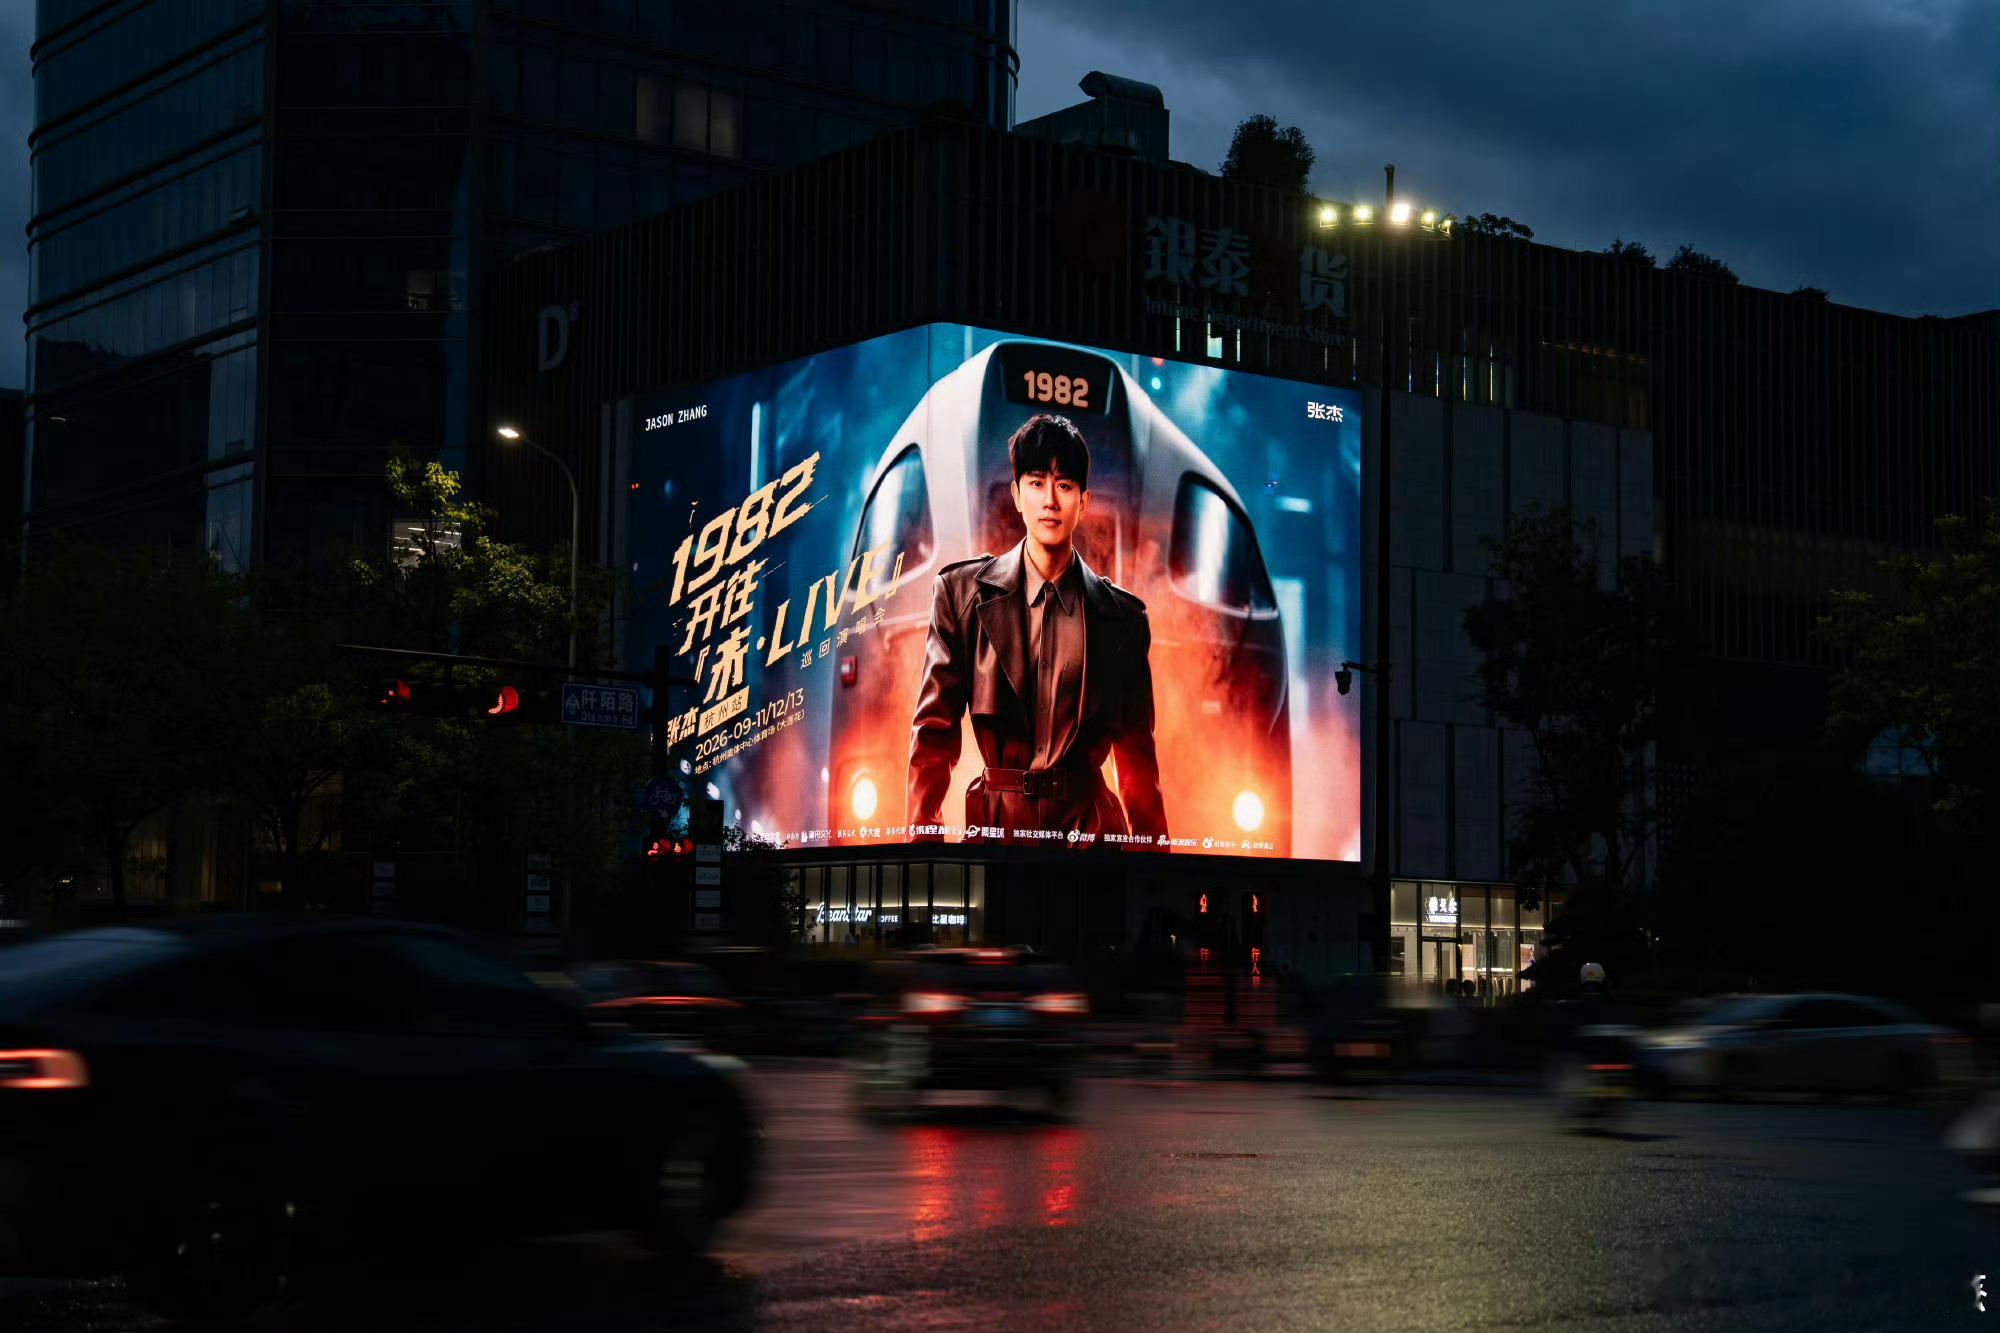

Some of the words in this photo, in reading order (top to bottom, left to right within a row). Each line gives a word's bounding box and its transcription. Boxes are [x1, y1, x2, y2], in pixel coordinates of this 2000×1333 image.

[1303, 322, 1347, 346] Store
[1024, 370, 1089, 409] 1982
[645, 412, 674, 432] JASON
[677, 404, 708, 424] ZHANG
[1307, 402, 1344, 423] 张杰
[669, 450, 821, 607] 1982
[675, 560, 769, 656] 开往
[800, 607, 886, 669] 巡回演唱会
[581, 689, 634, 712] 阡陌路
[622, 713, 634, 726] Rd
[667, 706, 700, 747] 张杰
[704, 694, 744, 730] 杭州站
[694, 687, 804, 762] 2026-09-11/12/13
[880, 914, 899, 923] OFFEE
